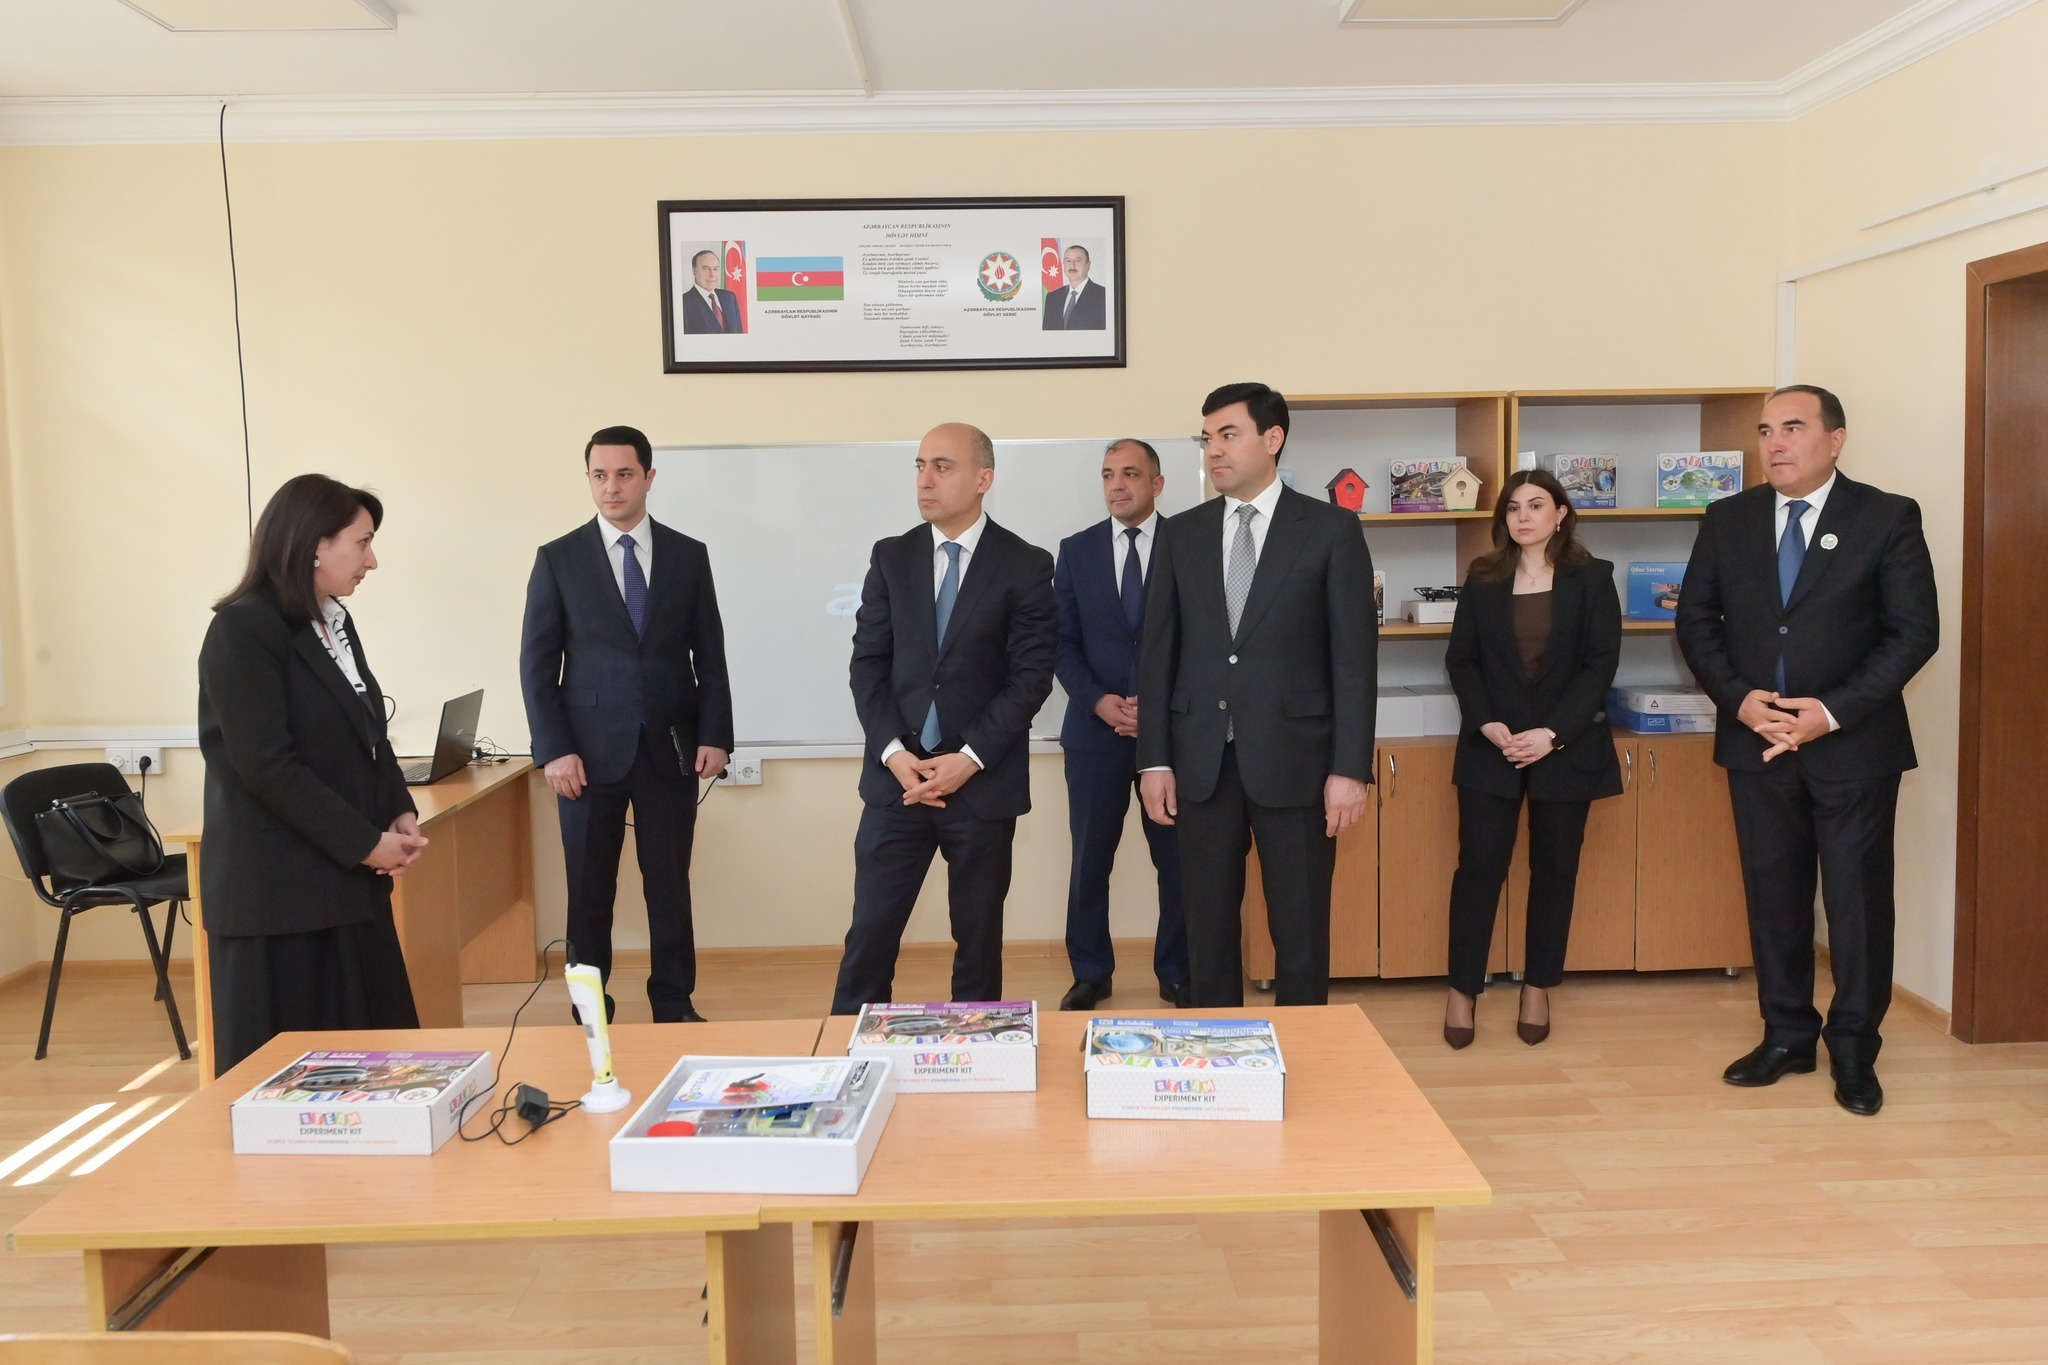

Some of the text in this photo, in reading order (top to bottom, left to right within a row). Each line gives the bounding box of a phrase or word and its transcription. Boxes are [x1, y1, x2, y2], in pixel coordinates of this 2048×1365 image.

[1571, 457, 1615, 470] STEAM
[1676, 456, 1739, 470] STEAM
[914, 1052, 972, 1065] STEAM
[1095, 1053, 1236, 1068] STEAM
[1154, 1079, 1216, 1093] STEAM
[253, 1088, 400, 1102] STEAM
[300, 1112, 362, 1126] STEAM
